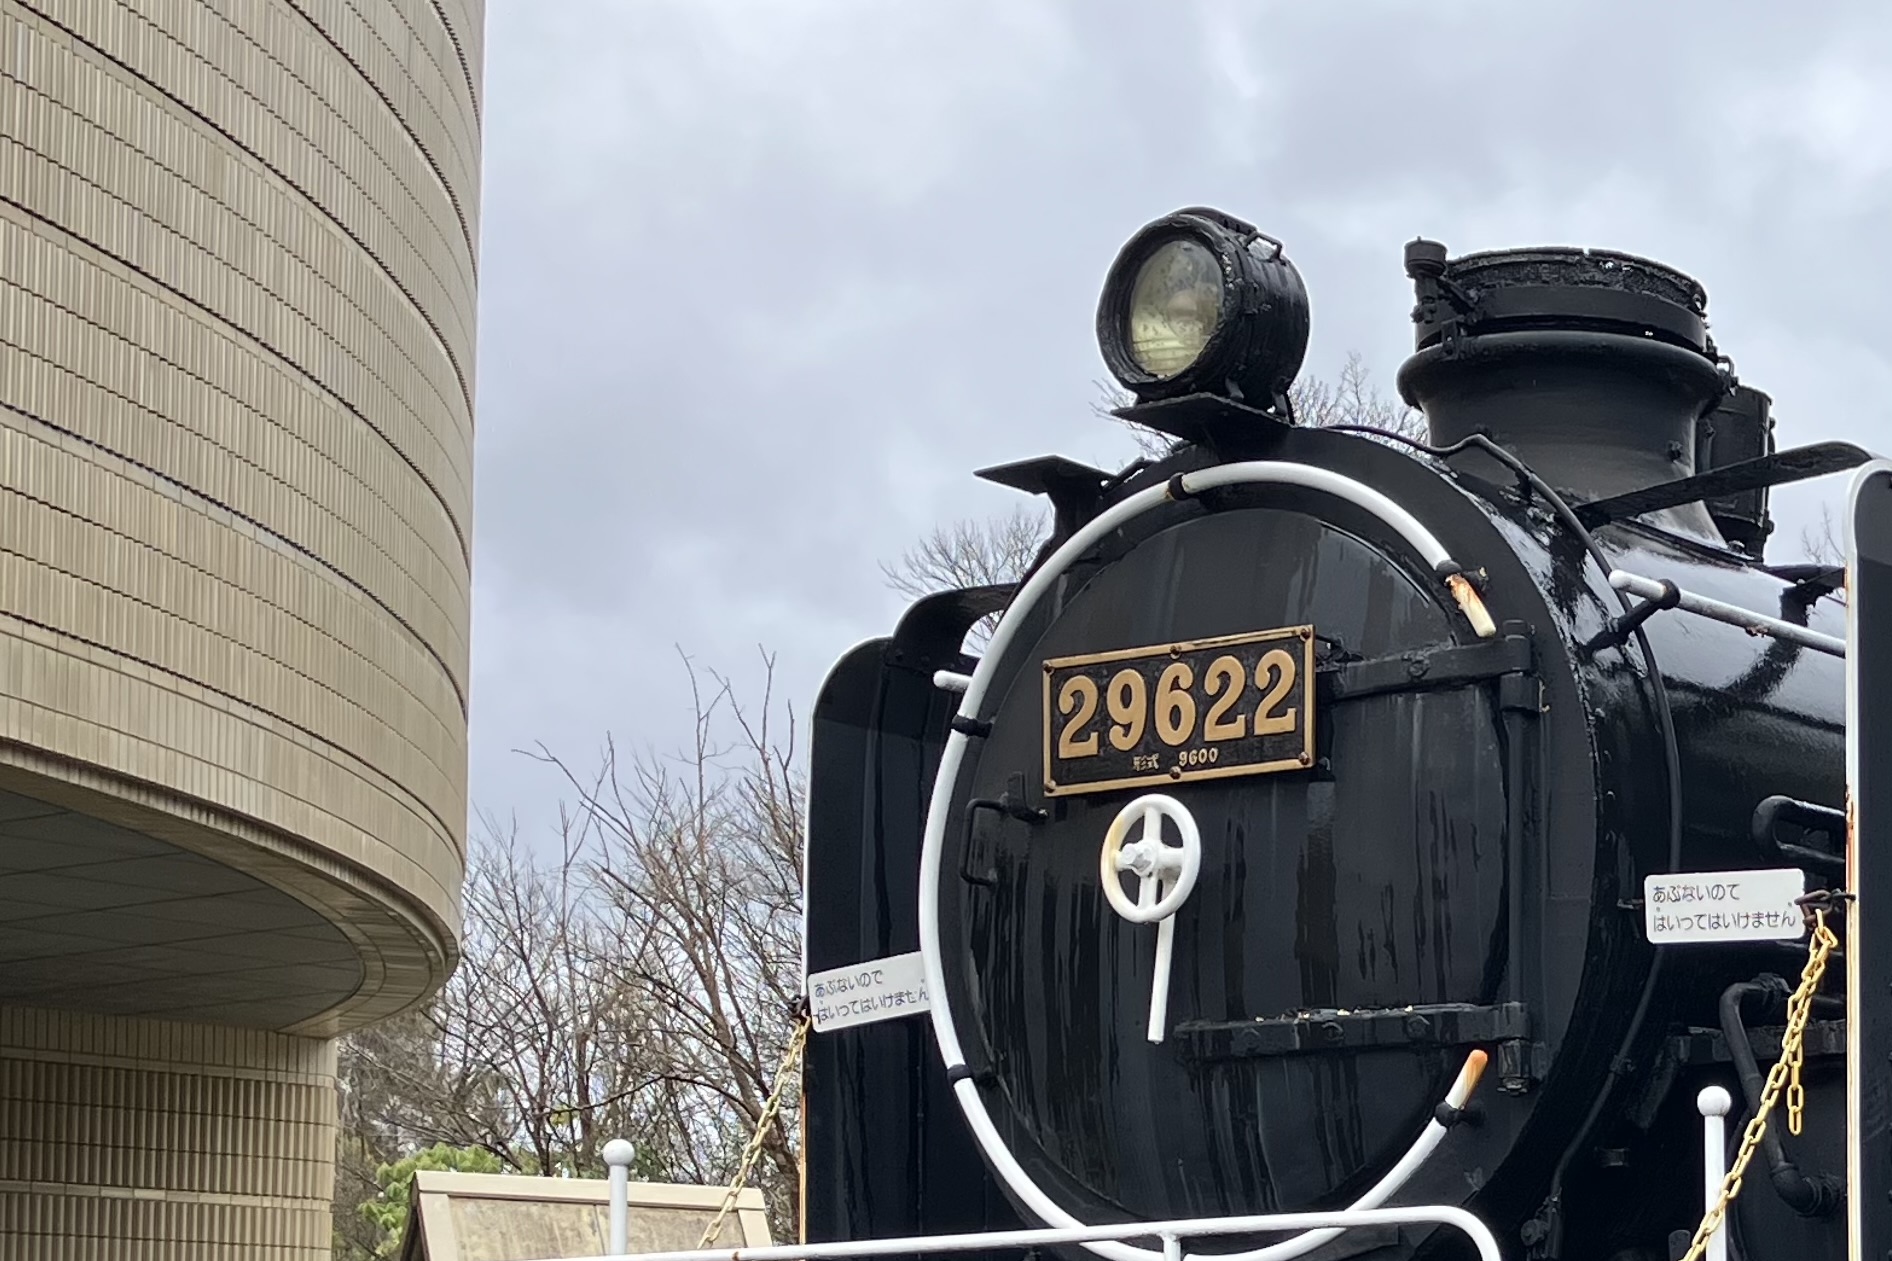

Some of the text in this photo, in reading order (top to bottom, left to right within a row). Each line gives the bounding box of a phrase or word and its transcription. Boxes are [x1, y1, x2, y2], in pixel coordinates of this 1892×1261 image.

[1058, 649, 1296, 759] 29622
[1133, 747, 1218, 771] 形式 9600
